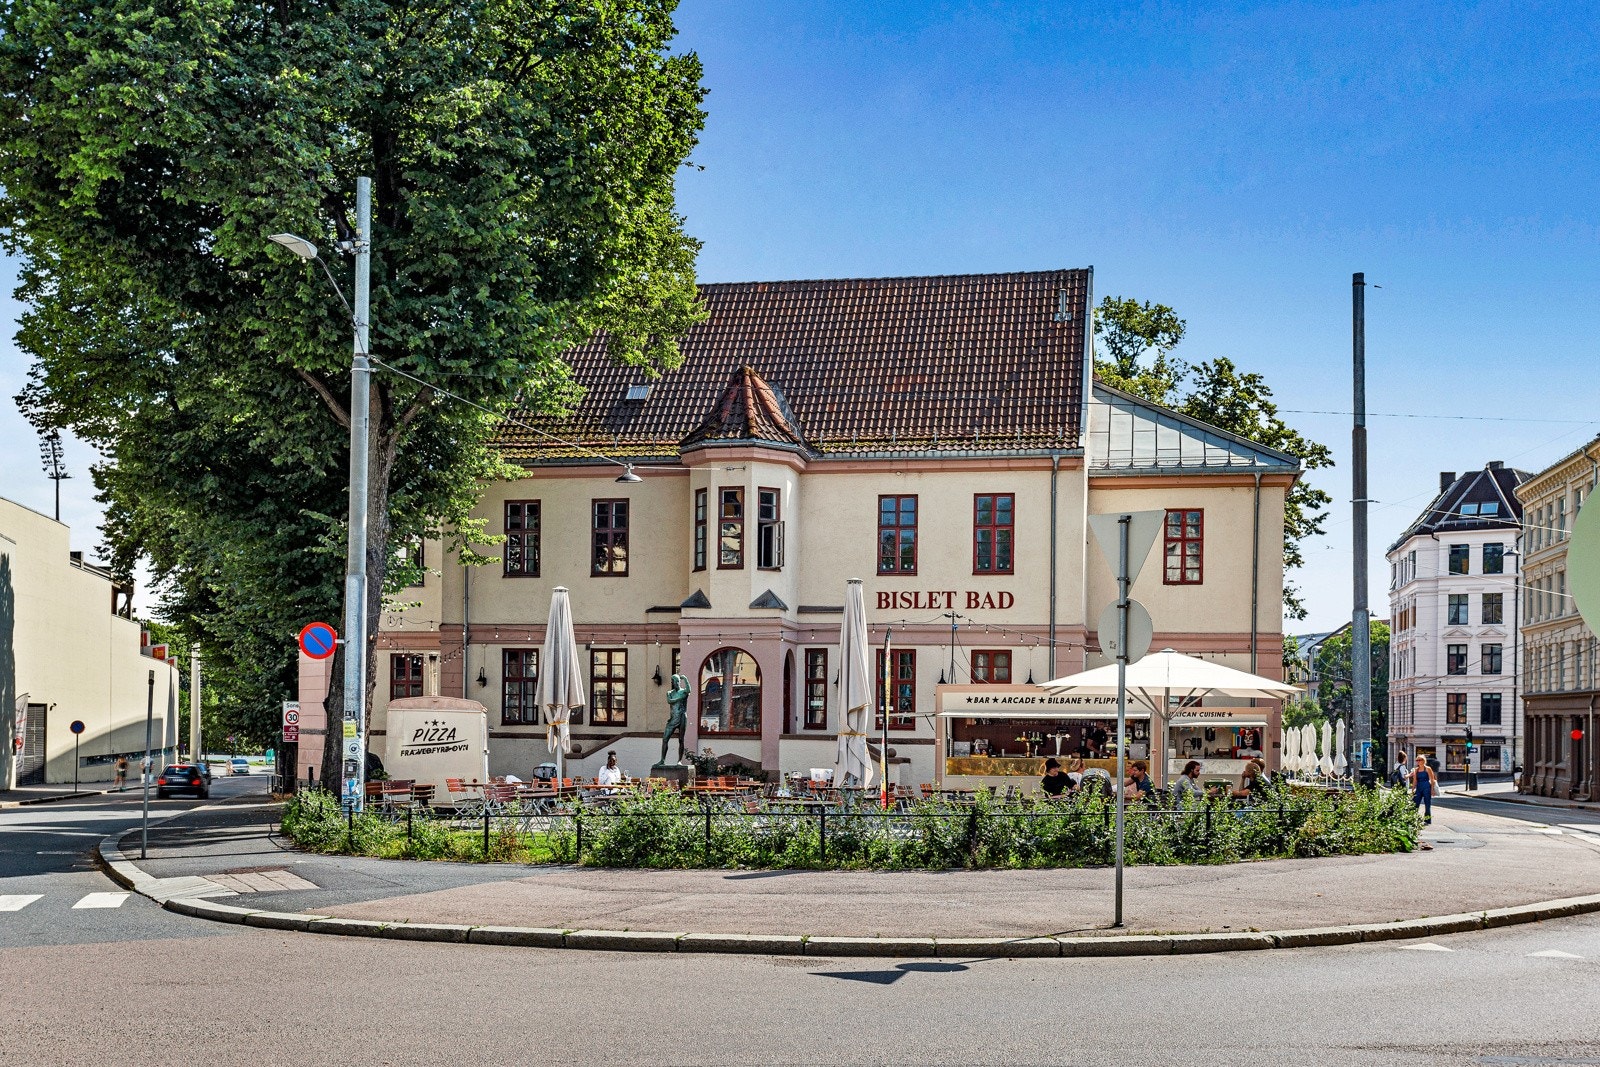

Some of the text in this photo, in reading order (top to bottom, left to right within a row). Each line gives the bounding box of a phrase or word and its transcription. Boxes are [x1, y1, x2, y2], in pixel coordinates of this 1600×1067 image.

[876, 591, 1015, 609] BISLET BAD
[288, 713, 298, 722] 30
[413, 727, 457, 742] PIZZA
